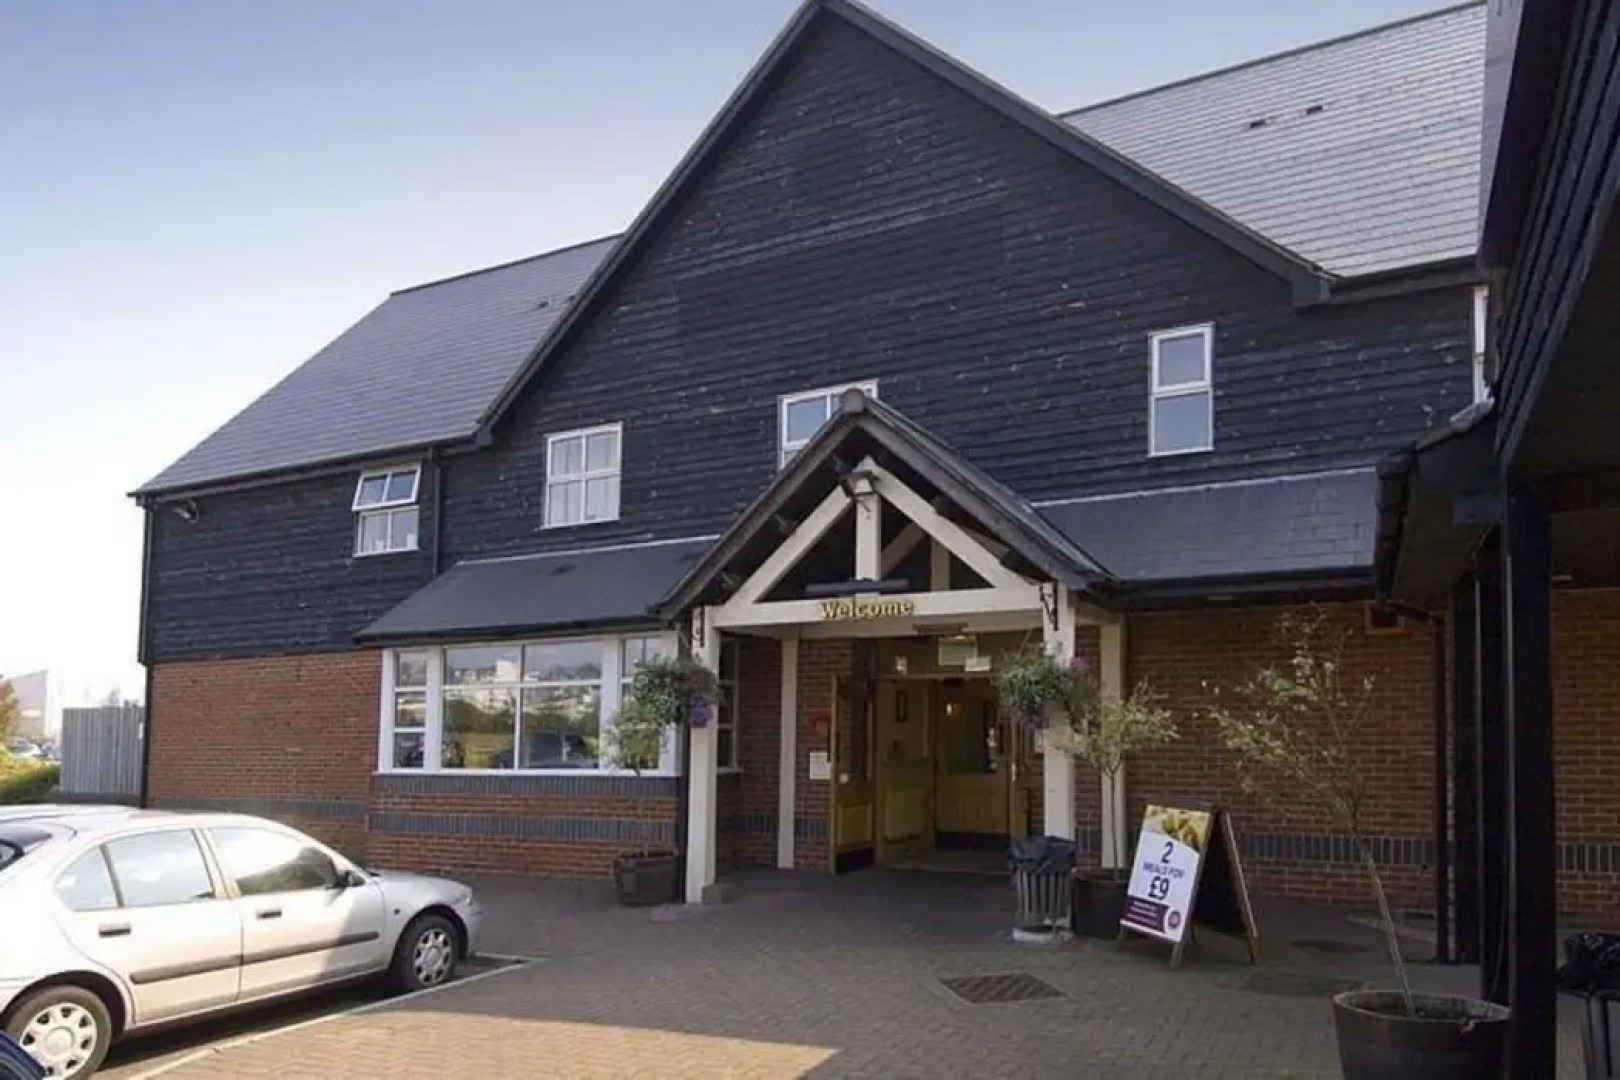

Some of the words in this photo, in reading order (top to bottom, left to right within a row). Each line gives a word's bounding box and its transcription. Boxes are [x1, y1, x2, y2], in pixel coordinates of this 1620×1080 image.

[820, 599, 914, 621] Welcome
[1161, 841, 1174, 864] 2
[1148, 876, 1169, 901] £9
